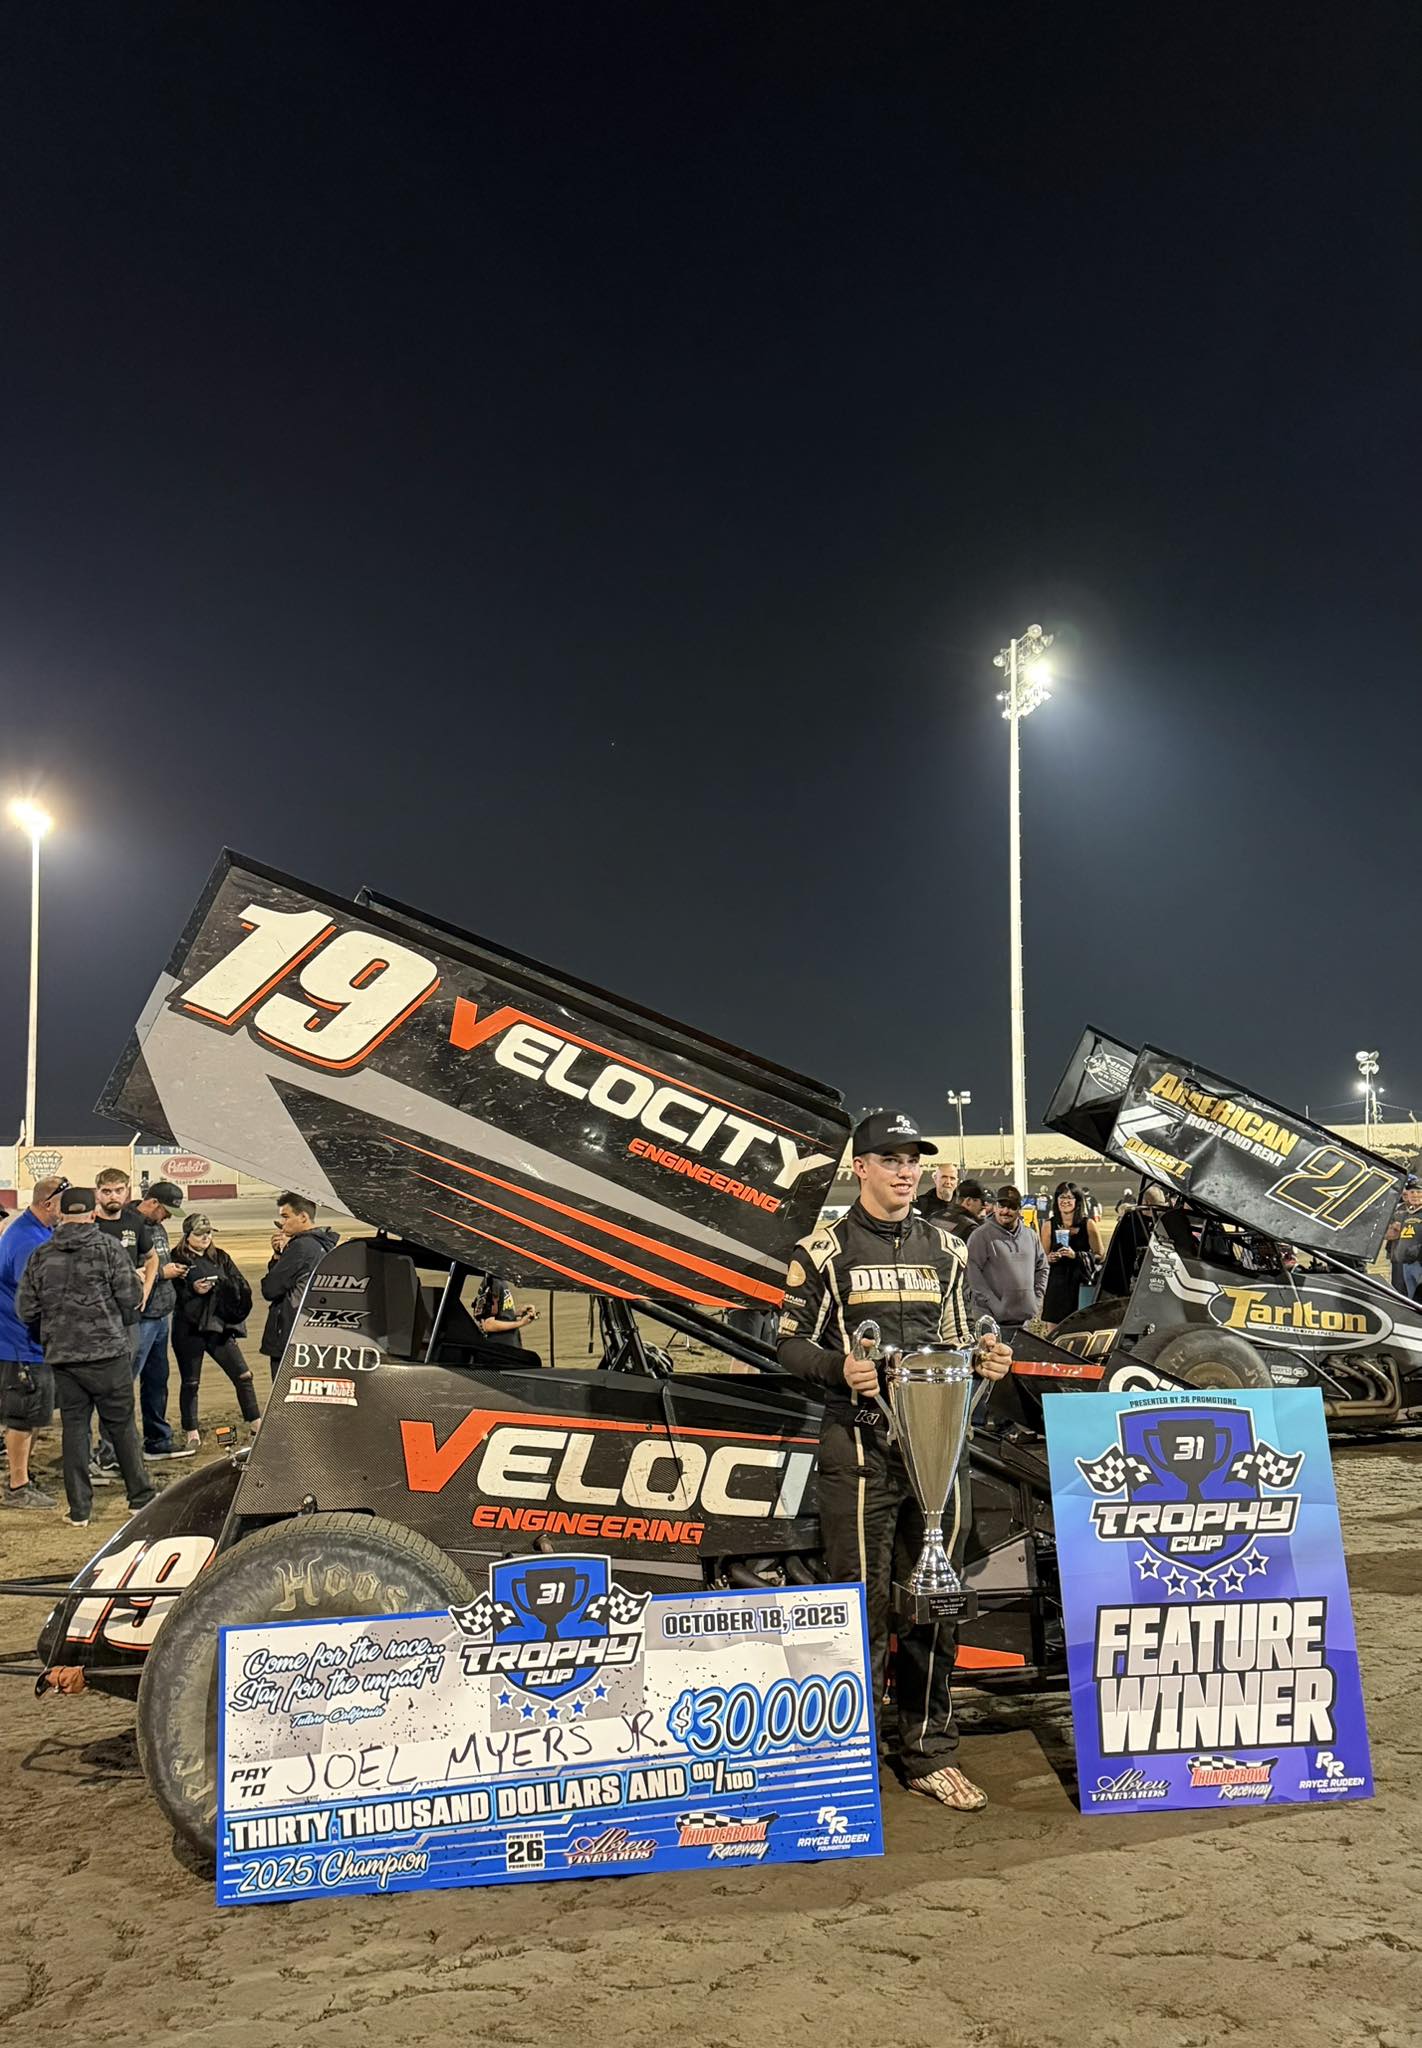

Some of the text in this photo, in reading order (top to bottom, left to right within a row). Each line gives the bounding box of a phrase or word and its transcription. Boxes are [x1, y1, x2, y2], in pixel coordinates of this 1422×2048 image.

[181, 904, 440, 1070] 19
[449, 996, 836, 1189] VELOCITY
[1151, 1072, 1300, 1156] AMERICAN
[1124, 1137, 1192, 1176] DURST
[1185, 1113, 1287, 1167] ROCK AND RENT
[628, 1137, 781, 1213] ENGINEERING
[1265, 1145, 1398, 1231] 21
[849, 1268, 912, 1291] DIRT
[1223, 1288, 1367, 1332] Tarlton
[293, 1343, 381, 1371] BYRD
[289, 1378, 336, 1395] DIRT
[1130, 1395, 1237, 1408] PRESENTED BY 26 PROMOTIONS
[400, 1409, 819, 1519] VELOCI
[1173, 1436, 1205, 1460] 31
[471, 1505, 705, 1545] ENGINEERING
[1098, 1501, 1294, 1535] TROPHY
[1170, 1535, 1223, 1552] CUP
[66, 1536, 217, 1650] 19
[536, 1582, 566, 1605] 31
[665, 1604, 846, 1636] OCTOBER 18, 2025
[464, 1635, 640, 1673] TROPHY
[1097, 1600, 1325, 1677] FEATURE
[243, 1636, 445, 1680] Come for the race...
[229, 1656, 445, 1714] Stay for the impact!
[525, 1668, 574, 1686] CUP
[671, 1678, 860, 1752] $30,000
[1101, 1668, 1333, 1753] WINNER
[287, 1709, 668, 1794] JOEL MYERS JR.
[231, 1766, 272, 1783] PAY
[240, 1784, 266, 1798] TO
[1191, 1765, 1271, 1787] THUNDERBOWL
[1299, 1777, 1365, 1789] RAYCE RUDEEN
[229, 1811, 331, 1851] THIRTY
[338, 1791, 491, 1838] THOUSAND
[498, 1775, 619, 1819] DOLLARS
[628, 1766, 685, 1801] AND
[1092, 1790, 1165, 1801] VINEYARDS
[1219, 1784, 1272, 1800] Raceway
[679, 1821, 769, 1846] THUNDERBOWL
[797, 1833, 870, 1847] RAYCE RUDEEN
[508, 1840, 543, 1863] 26
[567, 1850, 651, 1866] VINEYARDS
[707, 1842, 769, 1860] Raceway
[239, 1850, 428, 1891] 2025 Champion
